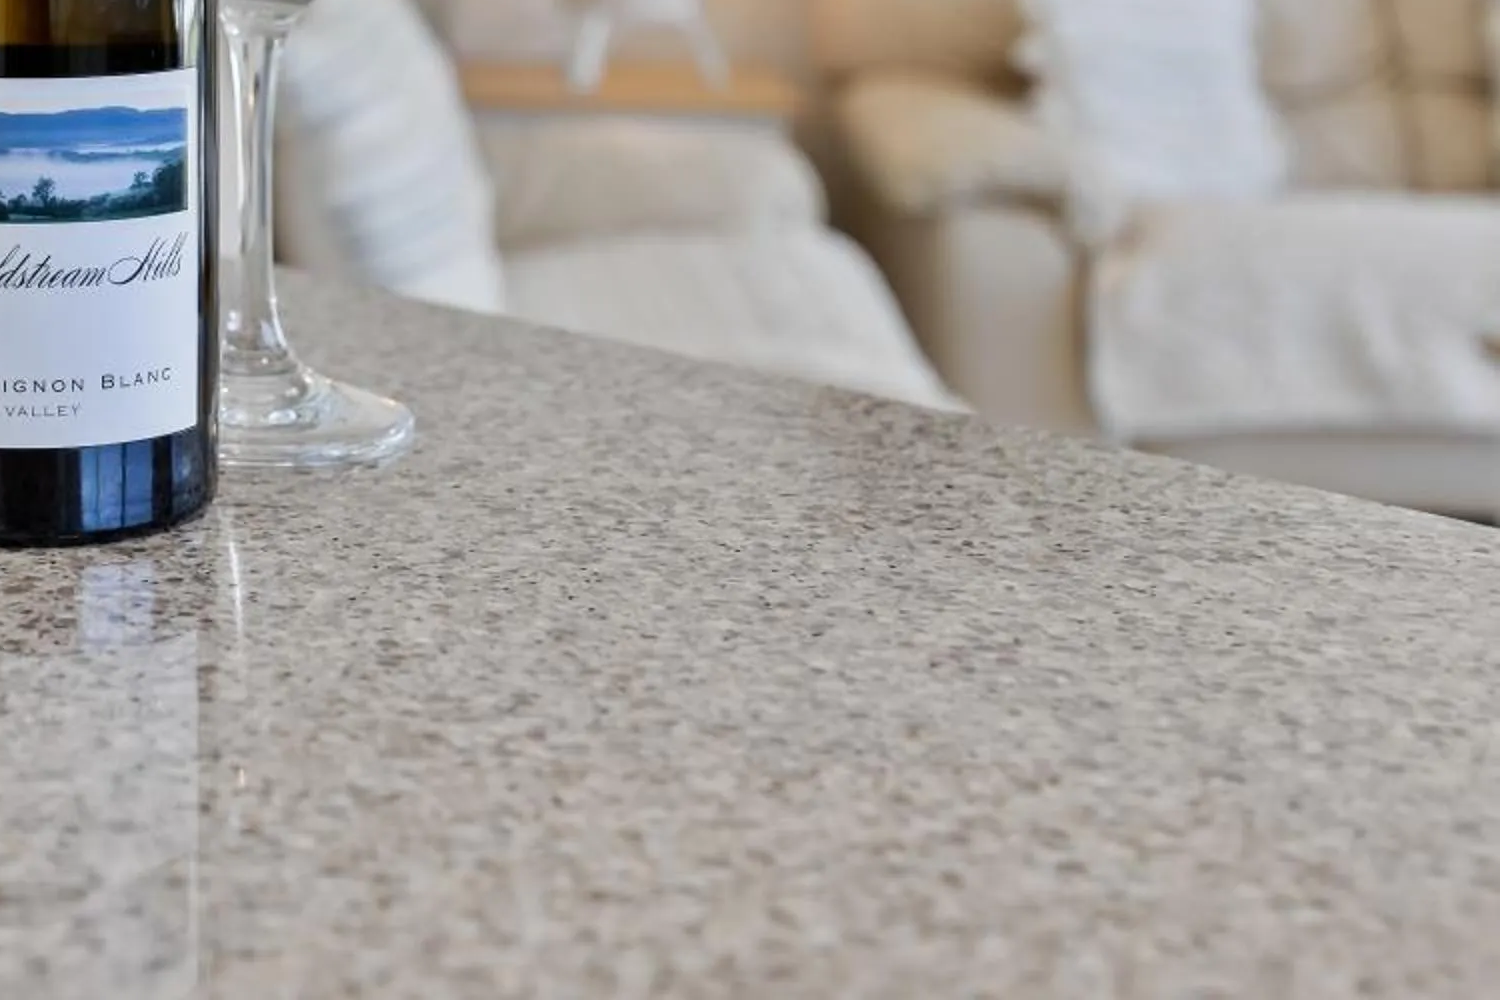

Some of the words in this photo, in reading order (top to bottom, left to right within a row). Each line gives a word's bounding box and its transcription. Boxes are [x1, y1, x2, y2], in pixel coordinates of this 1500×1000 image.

[108, 231, 188, 285] Hills
[101, 367, 171, 390] BLANC
[5, 402, 81, 417] VALLEY
